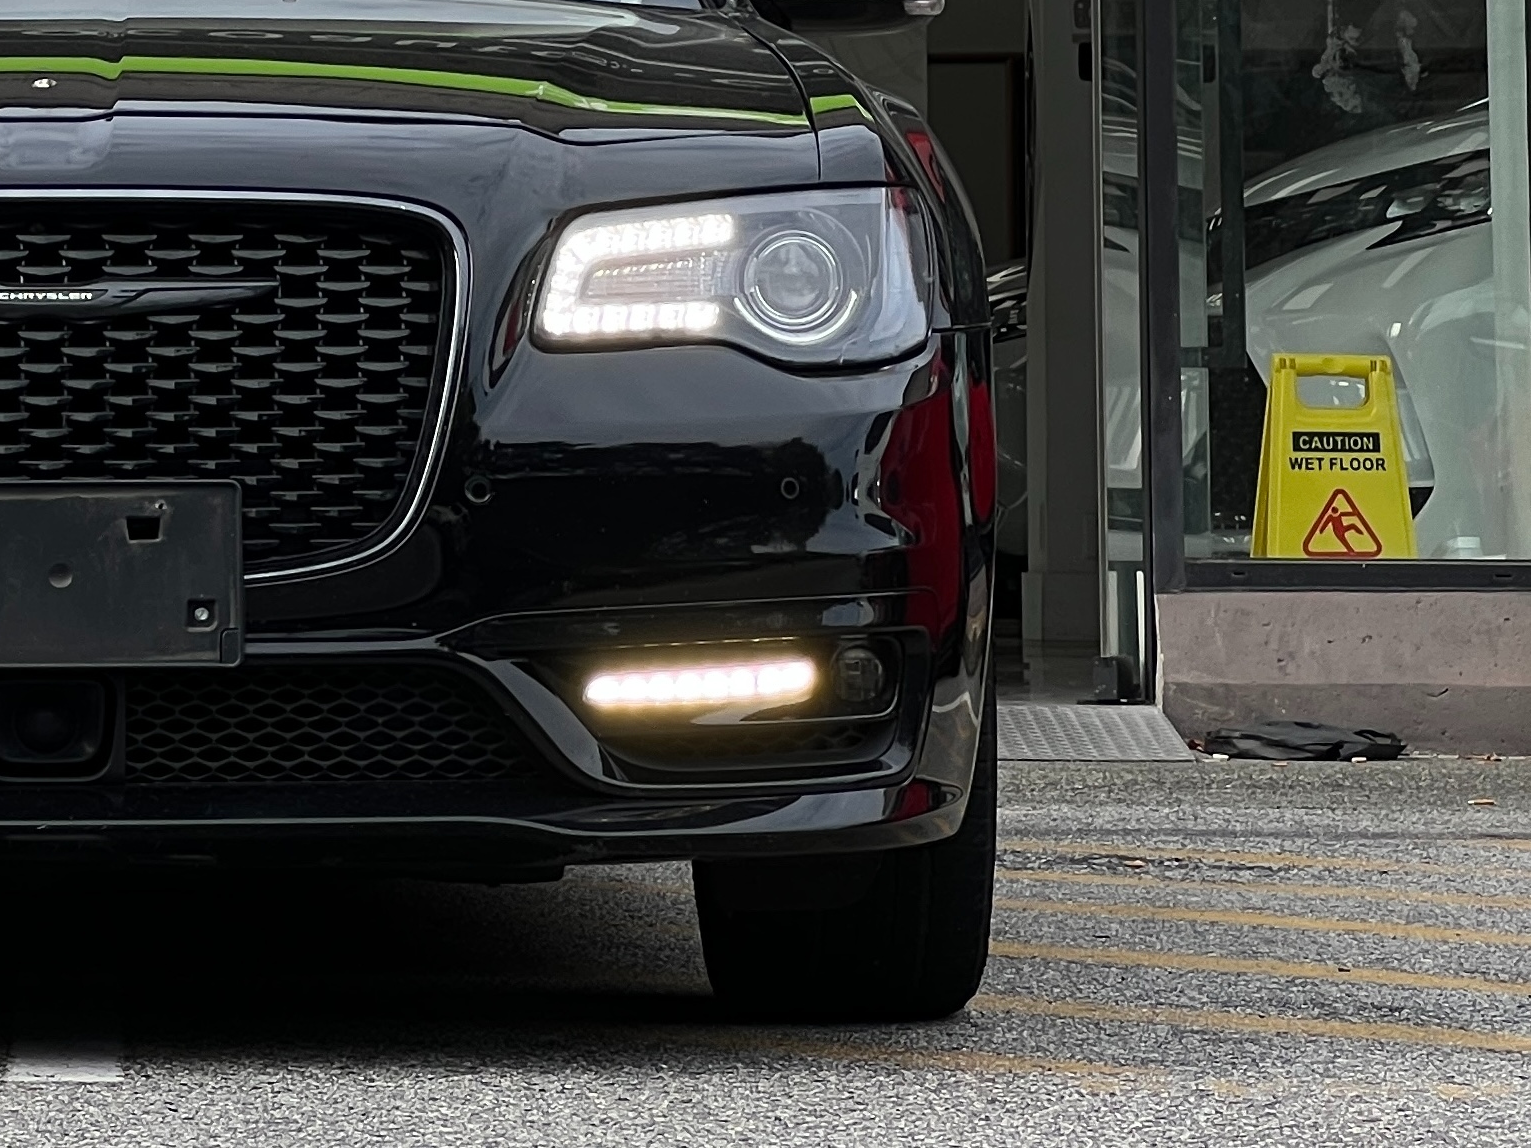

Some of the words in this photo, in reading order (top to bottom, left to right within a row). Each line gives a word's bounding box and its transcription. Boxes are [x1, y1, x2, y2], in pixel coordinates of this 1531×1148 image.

[1299, 435, 1374, 450] CAUTION
[1289, 457, 1324, 470] WET
[1330, 458, 1386, 471] FLOOR
